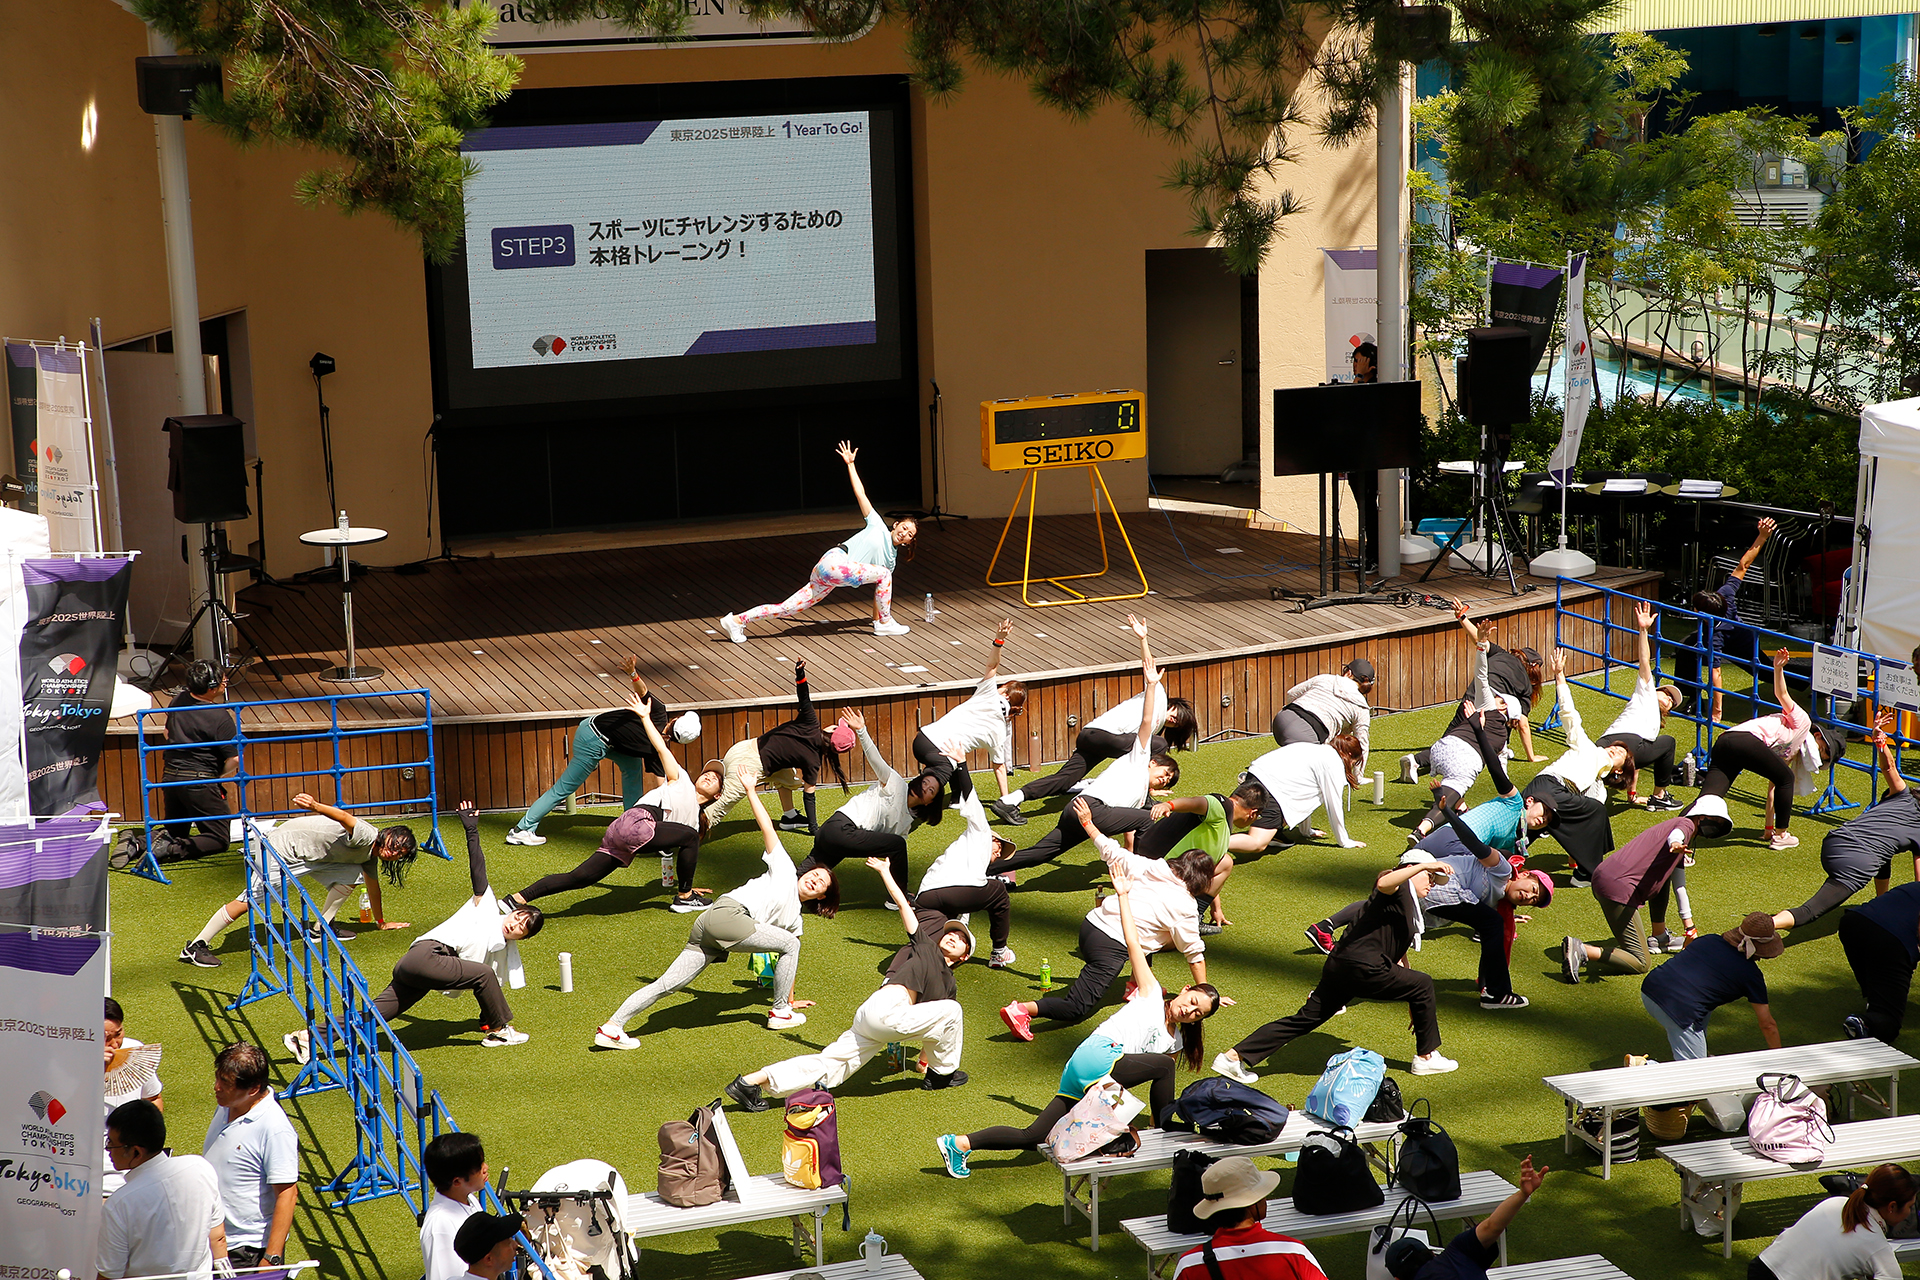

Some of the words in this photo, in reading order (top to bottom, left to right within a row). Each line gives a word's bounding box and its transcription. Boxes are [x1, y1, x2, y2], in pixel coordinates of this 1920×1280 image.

[670, 125, 776, 142] 東京2025世界陸上
[782, 121, 791, 139] 1
[794, 124, 821, 137] Year
[823, 123, 838, 135] To
[840, 121, 863, 134] Go!
[588, 209, 843, 242] スポーツにチャレンジするための
[500, 236, 567, 257] STEP3
[1023, 440, 1114, 466] SEIKO
[37, 610, 115, 627] 2025世界陸上
[1824, 656, 1848, 670] こまめに
[1820, 666, 1850, 680] 水分補給を
[1886, 673, 1912, 686] お食事は
[1821, 675, 1850, 690] しましょう
[60, 703, 102, 719] Tokyo
[0, 1018, 95, 1041] 京2025世界陸上
[21, 1123, 44, 1133] WORLD
[50, 1166, 90, 1197] oky
[16, 1198, 60, 1209] GEOGRAPHIC
[61, 1208, 76, 1216] OST
[0, 1264, 82, 1280] 東京2025
